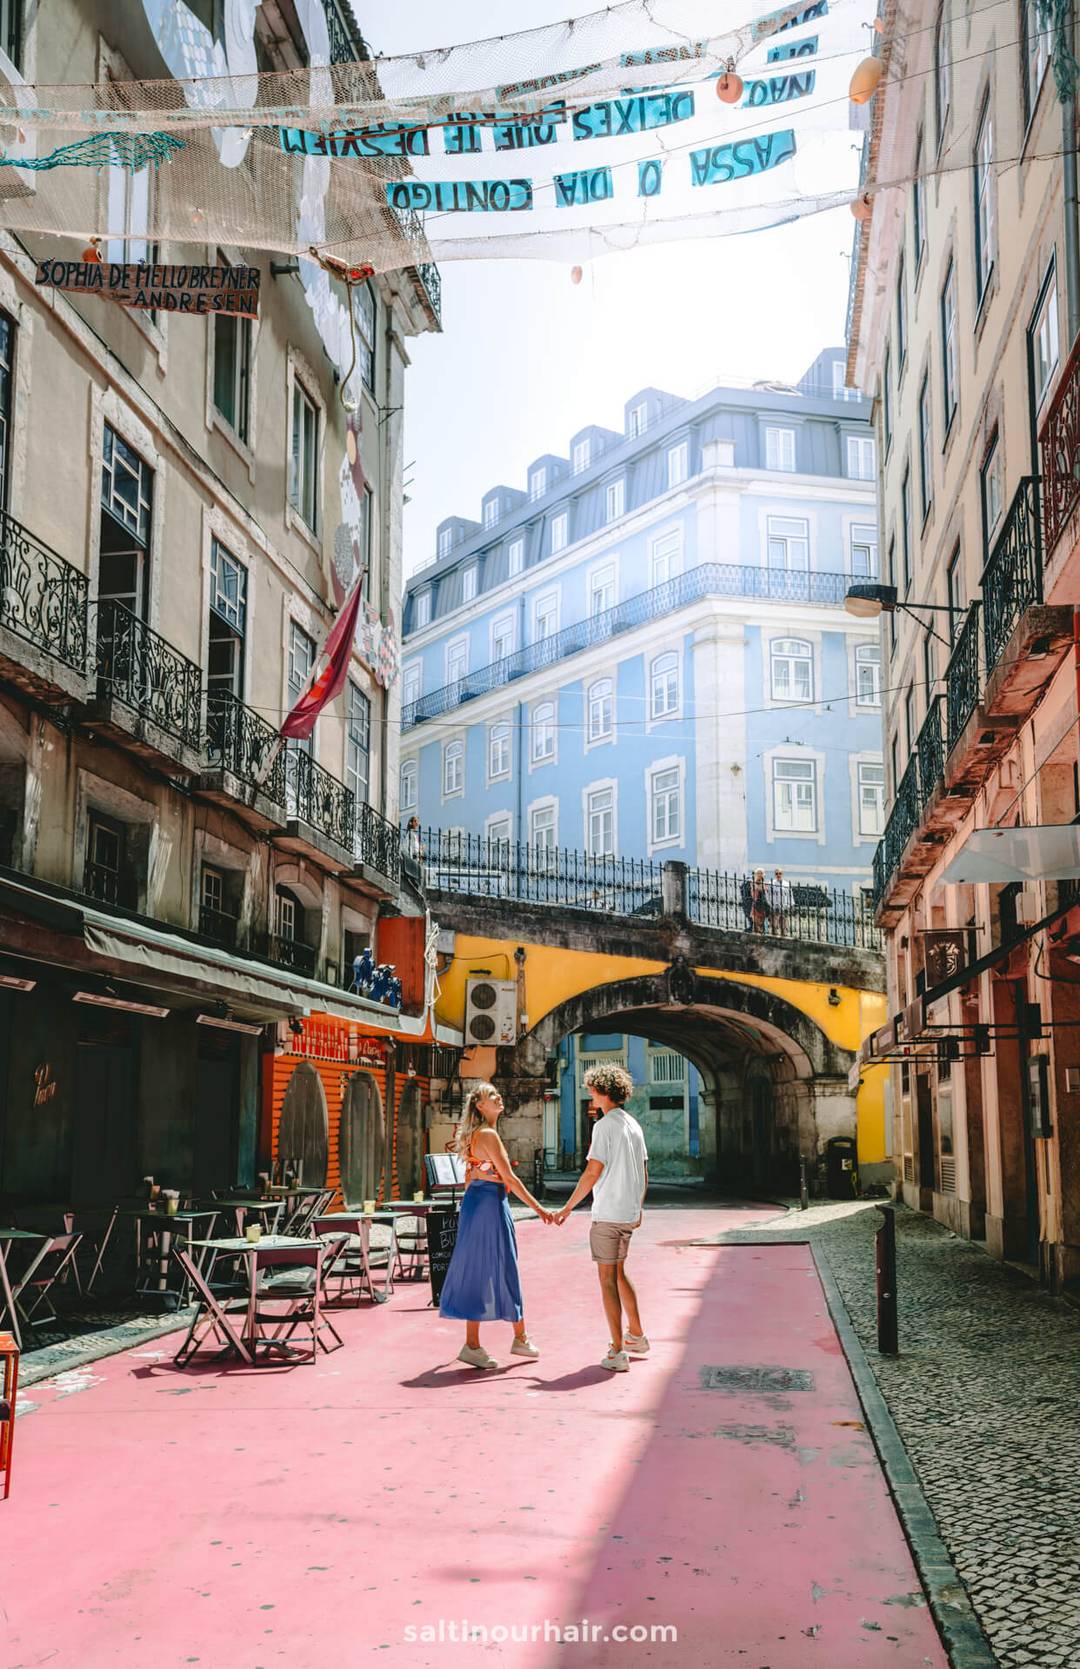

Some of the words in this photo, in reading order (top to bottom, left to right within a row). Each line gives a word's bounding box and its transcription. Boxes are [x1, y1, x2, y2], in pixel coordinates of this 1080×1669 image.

[573, 94, 694, 140] DEIXES
[444, 126, 481, 154] TE
[496, 125, 554, 151] QUE
[689, 130, 796, 187] PASSA
[391, 179, 532, 211] CONTIGO
[556, 168, 609, 207] DIA
[641, 161, 660, 197] O
[35, 262, 104, 288] SOPHIA
[109, 264, 131, 289] DE
[134, 289, 254, 313] ANDRESEN
